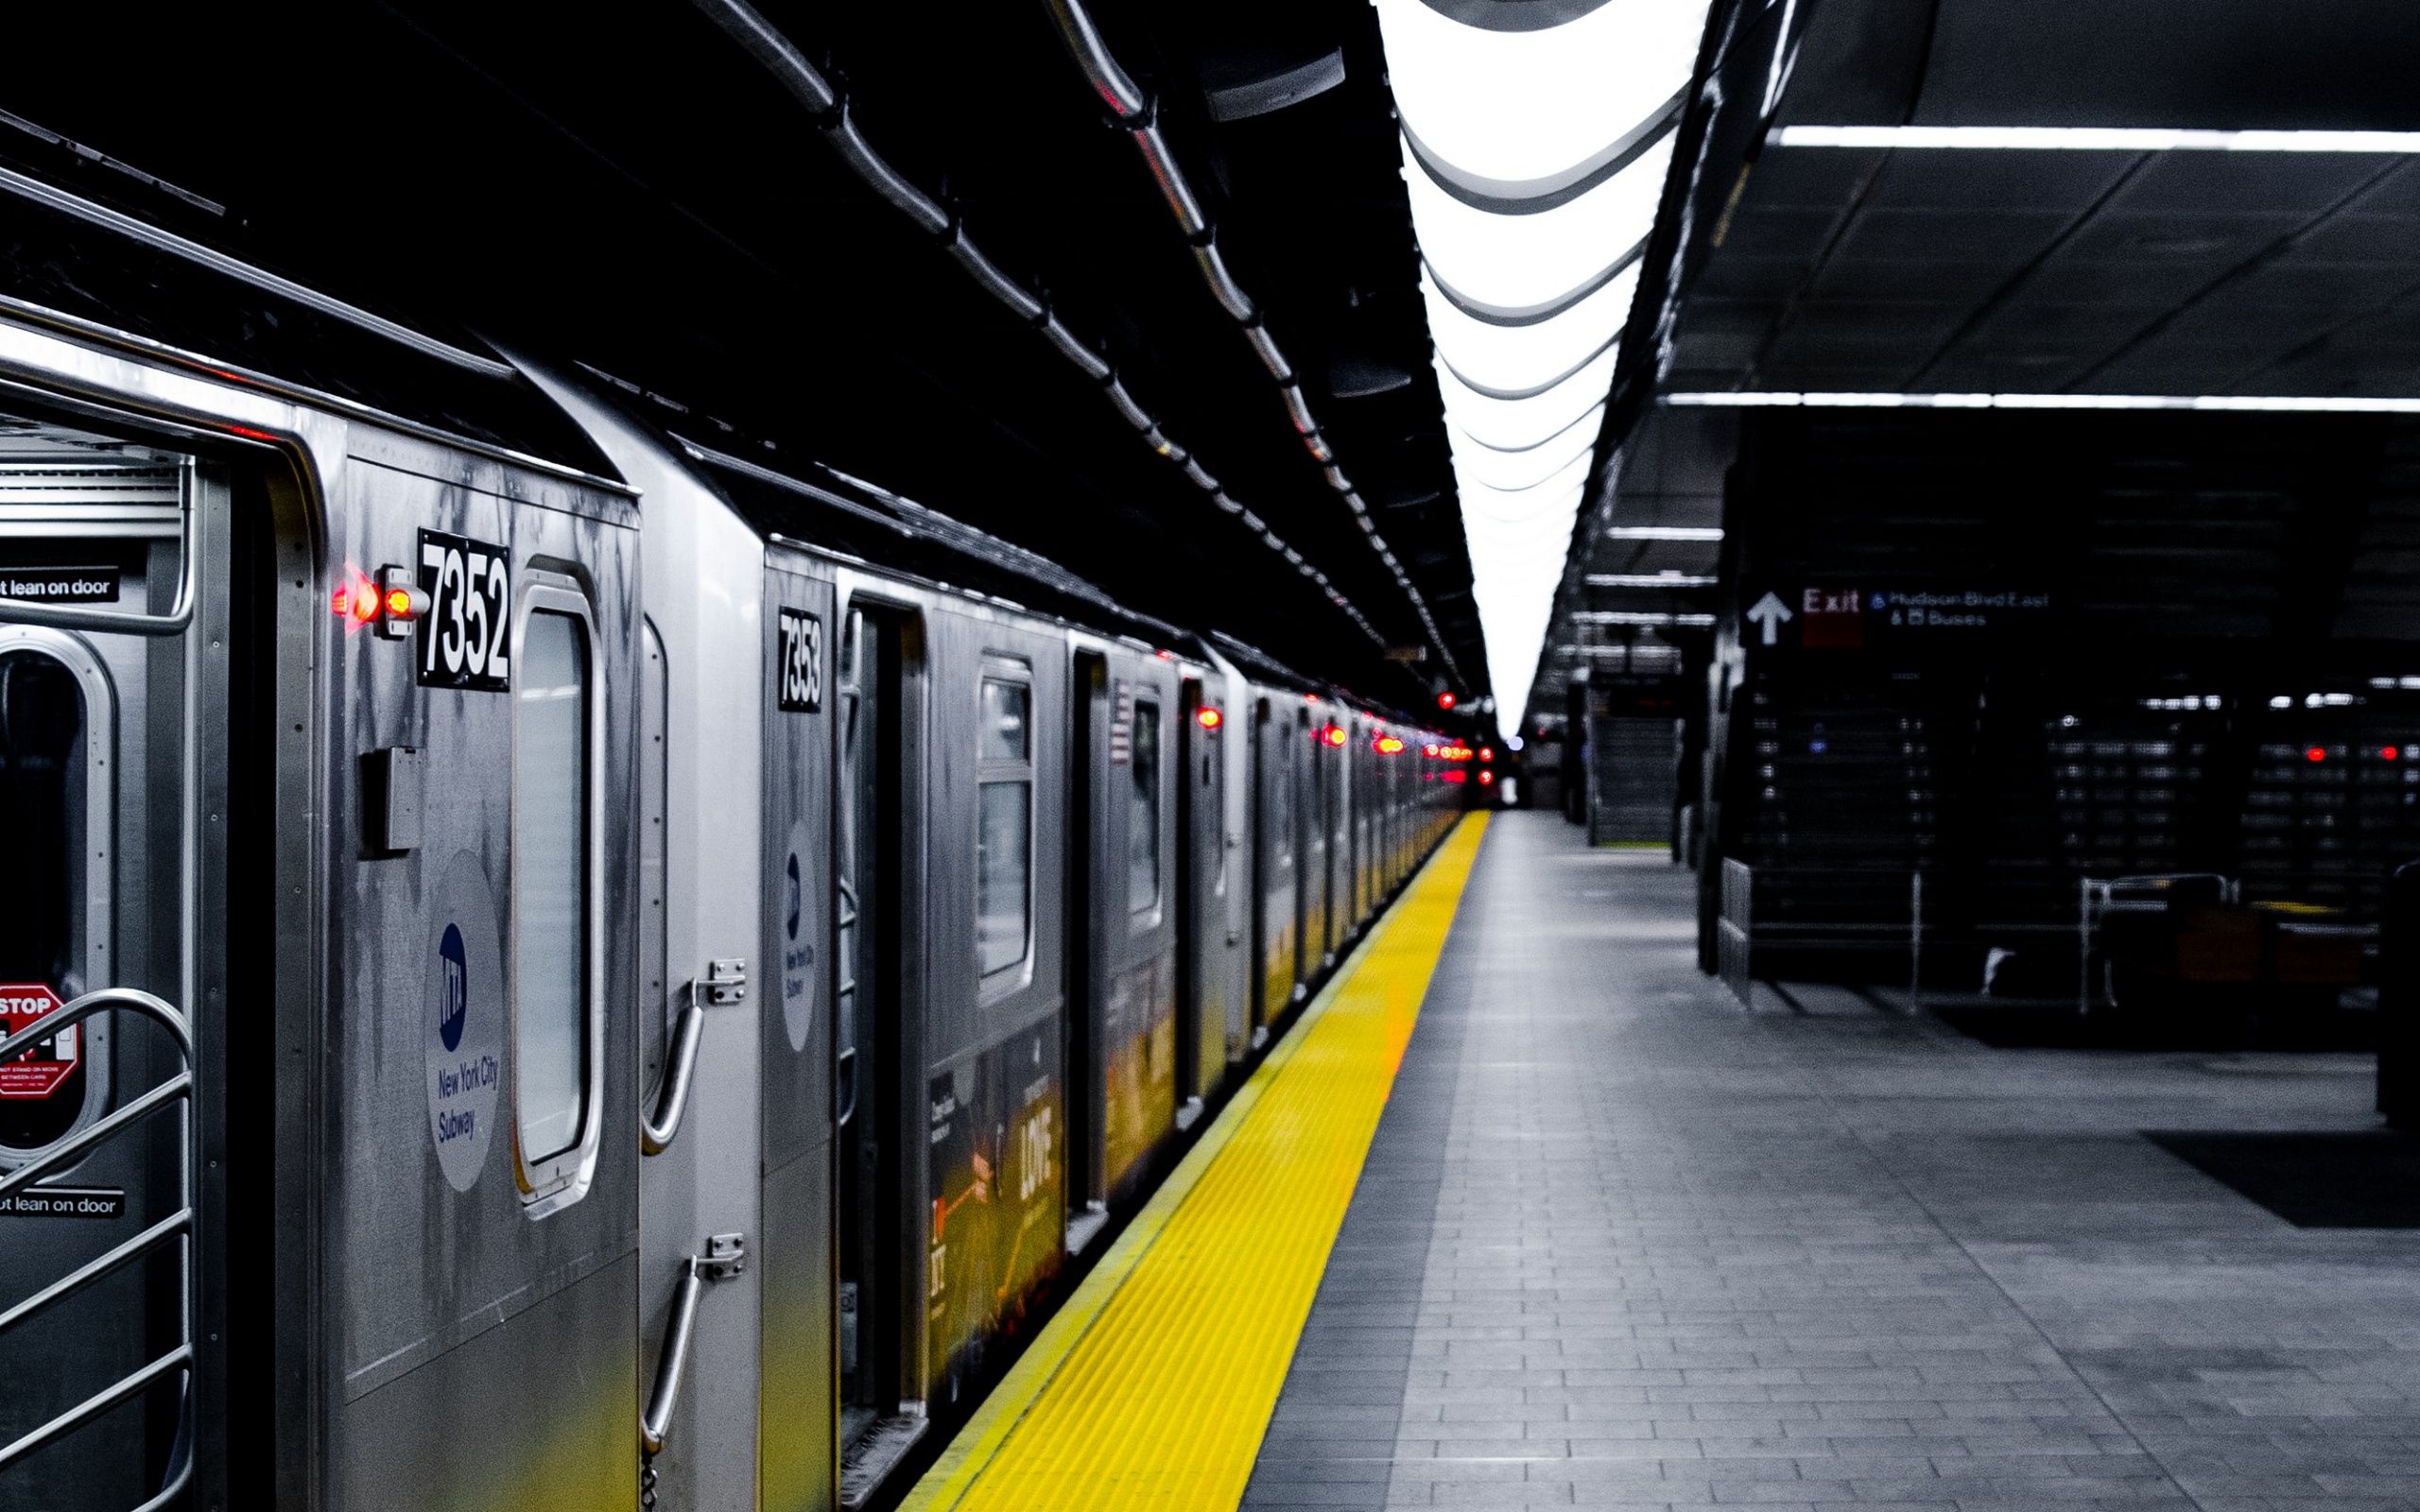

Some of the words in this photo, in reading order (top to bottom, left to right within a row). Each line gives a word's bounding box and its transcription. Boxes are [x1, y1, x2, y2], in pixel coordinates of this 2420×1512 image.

[10, 579, 45, 595] lean
[47, 582, 69, 595] on
[72, 578, 111, 594] door
[1803, 588, 1859, 613] Exit
[1889, 592, 1962, 607] Hudson
[2008, 592, 2050, 607] East
[423, 542, 509, 679] 7352
[1928, 610, 1986, 626] Buses
[781, 613, 821, 704] 7353
[0, 997, 51, 1015] STOP
[439, 1069, 459, 1100] New
[459, 1059, 480, 1092] York
[480, 1055, 500, 1091] City
[439, 1108, 475, 1143] Subway
[15, 1196, 49, 1211] lean
[53, 1200, 74, 1211] on
[78, 1198, 115, 1212] door
